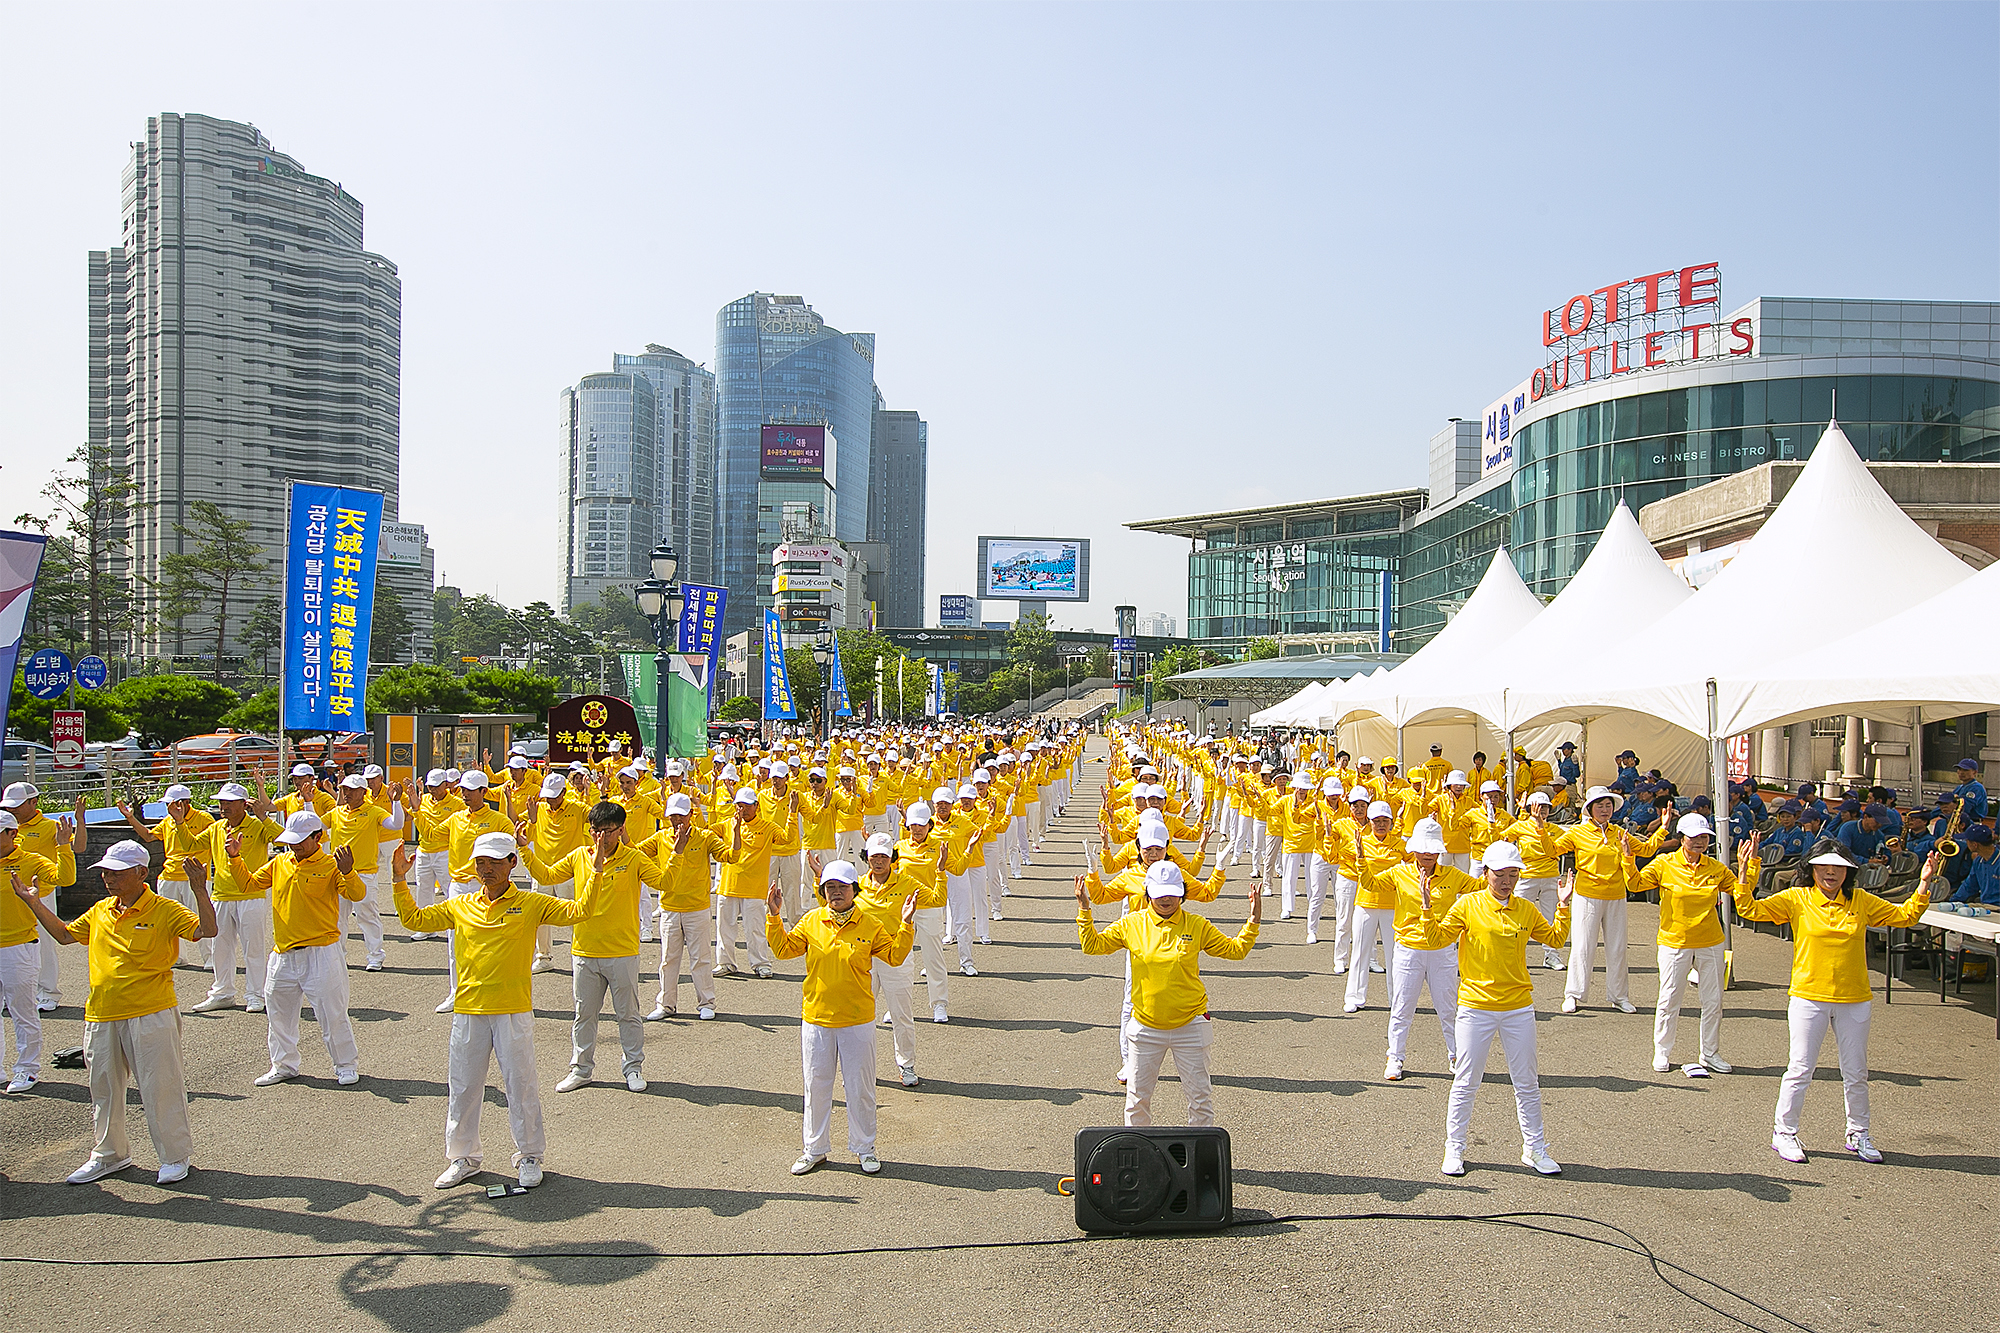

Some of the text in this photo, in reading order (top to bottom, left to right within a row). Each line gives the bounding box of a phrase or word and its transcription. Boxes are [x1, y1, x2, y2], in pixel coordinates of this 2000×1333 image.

[1543, 261, 1719, 346] LOTTE
[761, 320, 818, 335] KDB생명
[1531, 318, 1754, 401] OUTLETS
[1486, 447, 1502, 470] Seoul
[1652, 451, 1707, 464] CHINESE
[1719, 446, 1766, 458] BISTRO
[1253, 543, 1306, 569] 서울역
[302, 504, 329, 712] 공산당 탈퇴만이 살길이다!
[329, 507, 368, 717] 天滅中共 退黨保平安
[27, 671, 70, 687] 택시승차
[55, 716, 83, 726] 서울역
[55, 727, 83, 737] 주차장
[555, 730, 633, 745] 法輪大法
